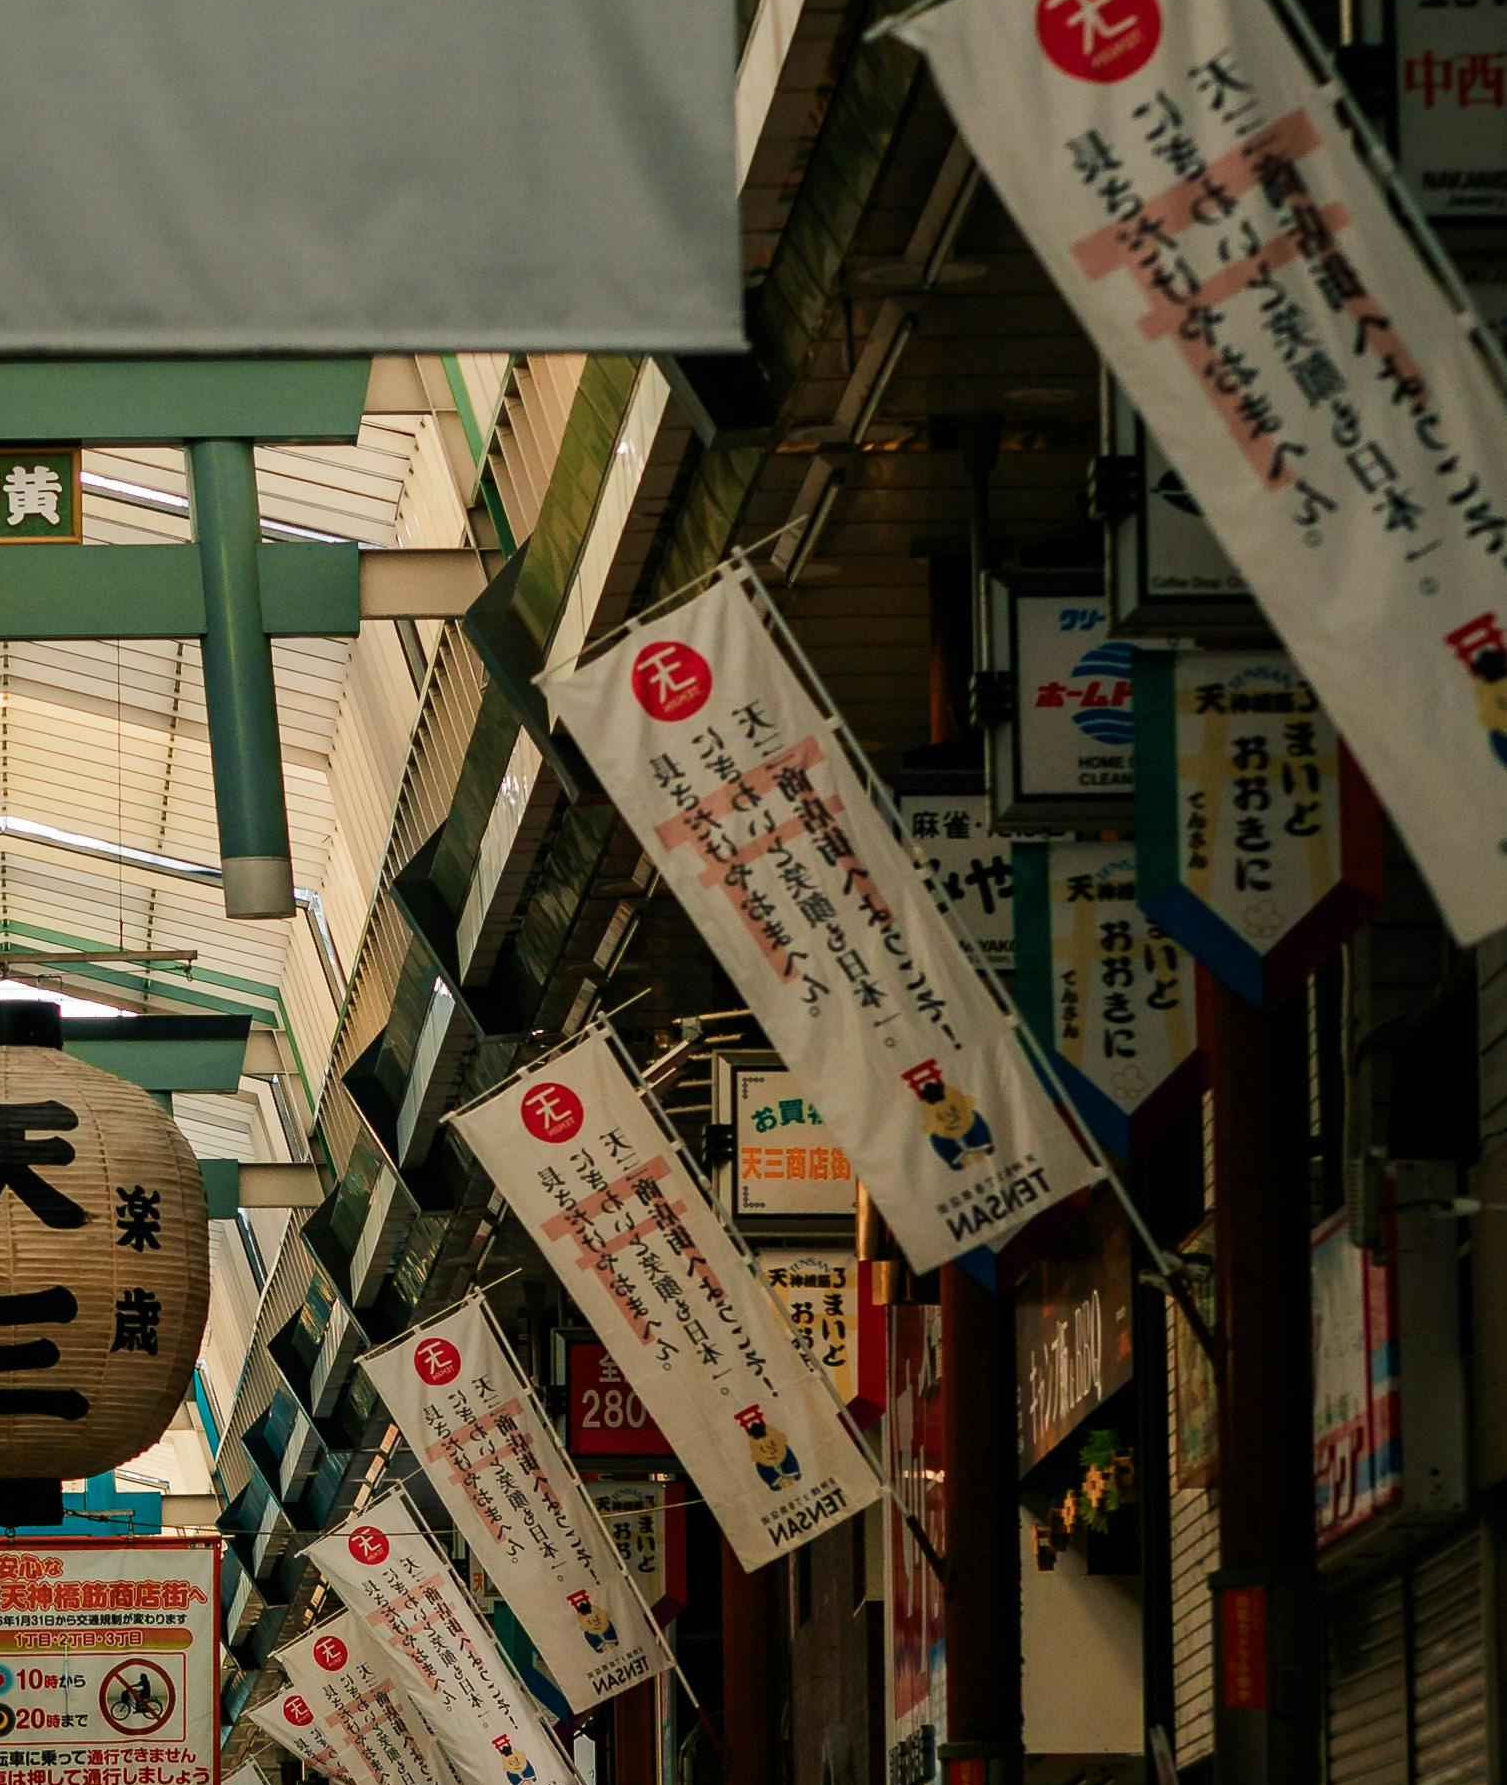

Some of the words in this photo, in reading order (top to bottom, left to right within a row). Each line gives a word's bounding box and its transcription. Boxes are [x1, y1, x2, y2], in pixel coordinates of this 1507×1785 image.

[1078, 756, 1124, 768] HOME
[1232, 735, 1272, 893] おおきに
[1100, 920, 1136, 1058] おおきに
[821, 1293, 847, 1368] まいど
[16, 1668, 87, 1691] 10時から
[15, 1707, 89, 1730] 20時まで
